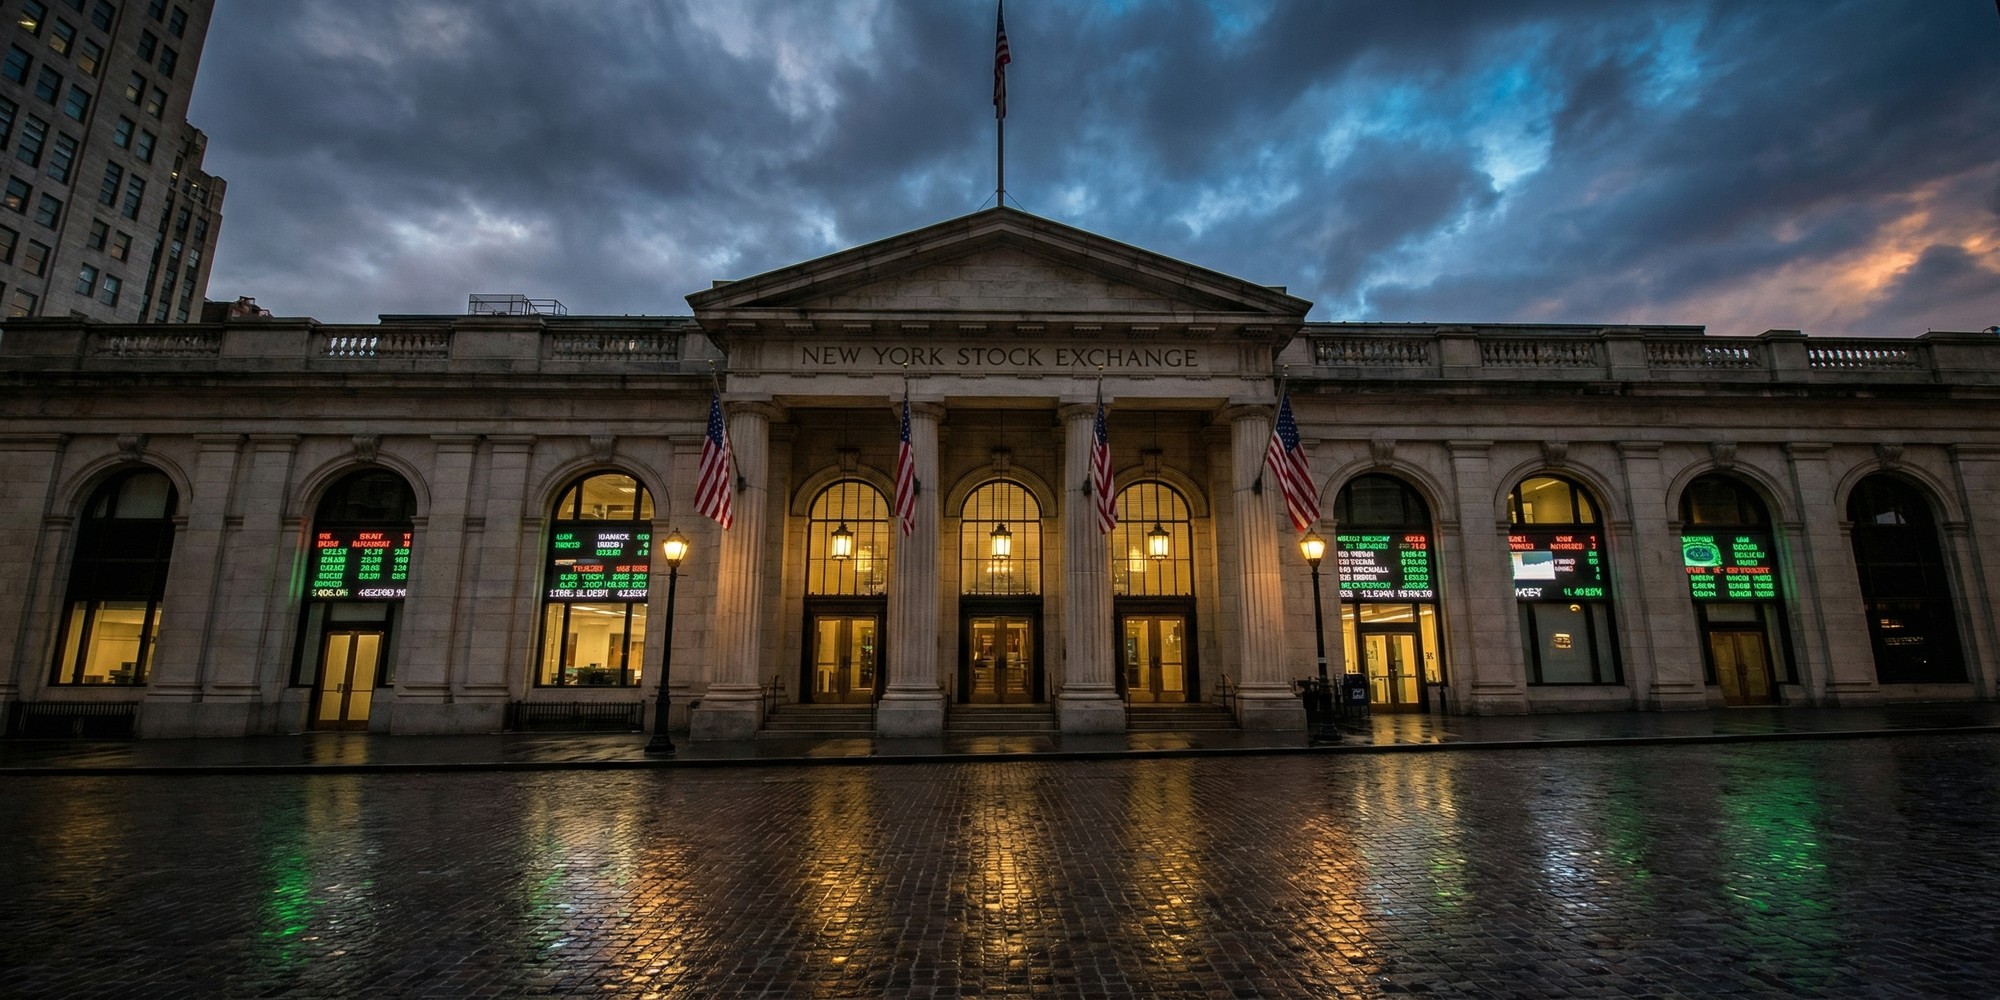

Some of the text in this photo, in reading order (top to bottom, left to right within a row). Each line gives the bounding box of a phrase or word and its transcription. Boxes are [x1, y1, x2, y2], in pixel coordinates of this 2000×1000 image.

[801, 347, 1199, 368] NEW YORK STOCK EXCHANGE
